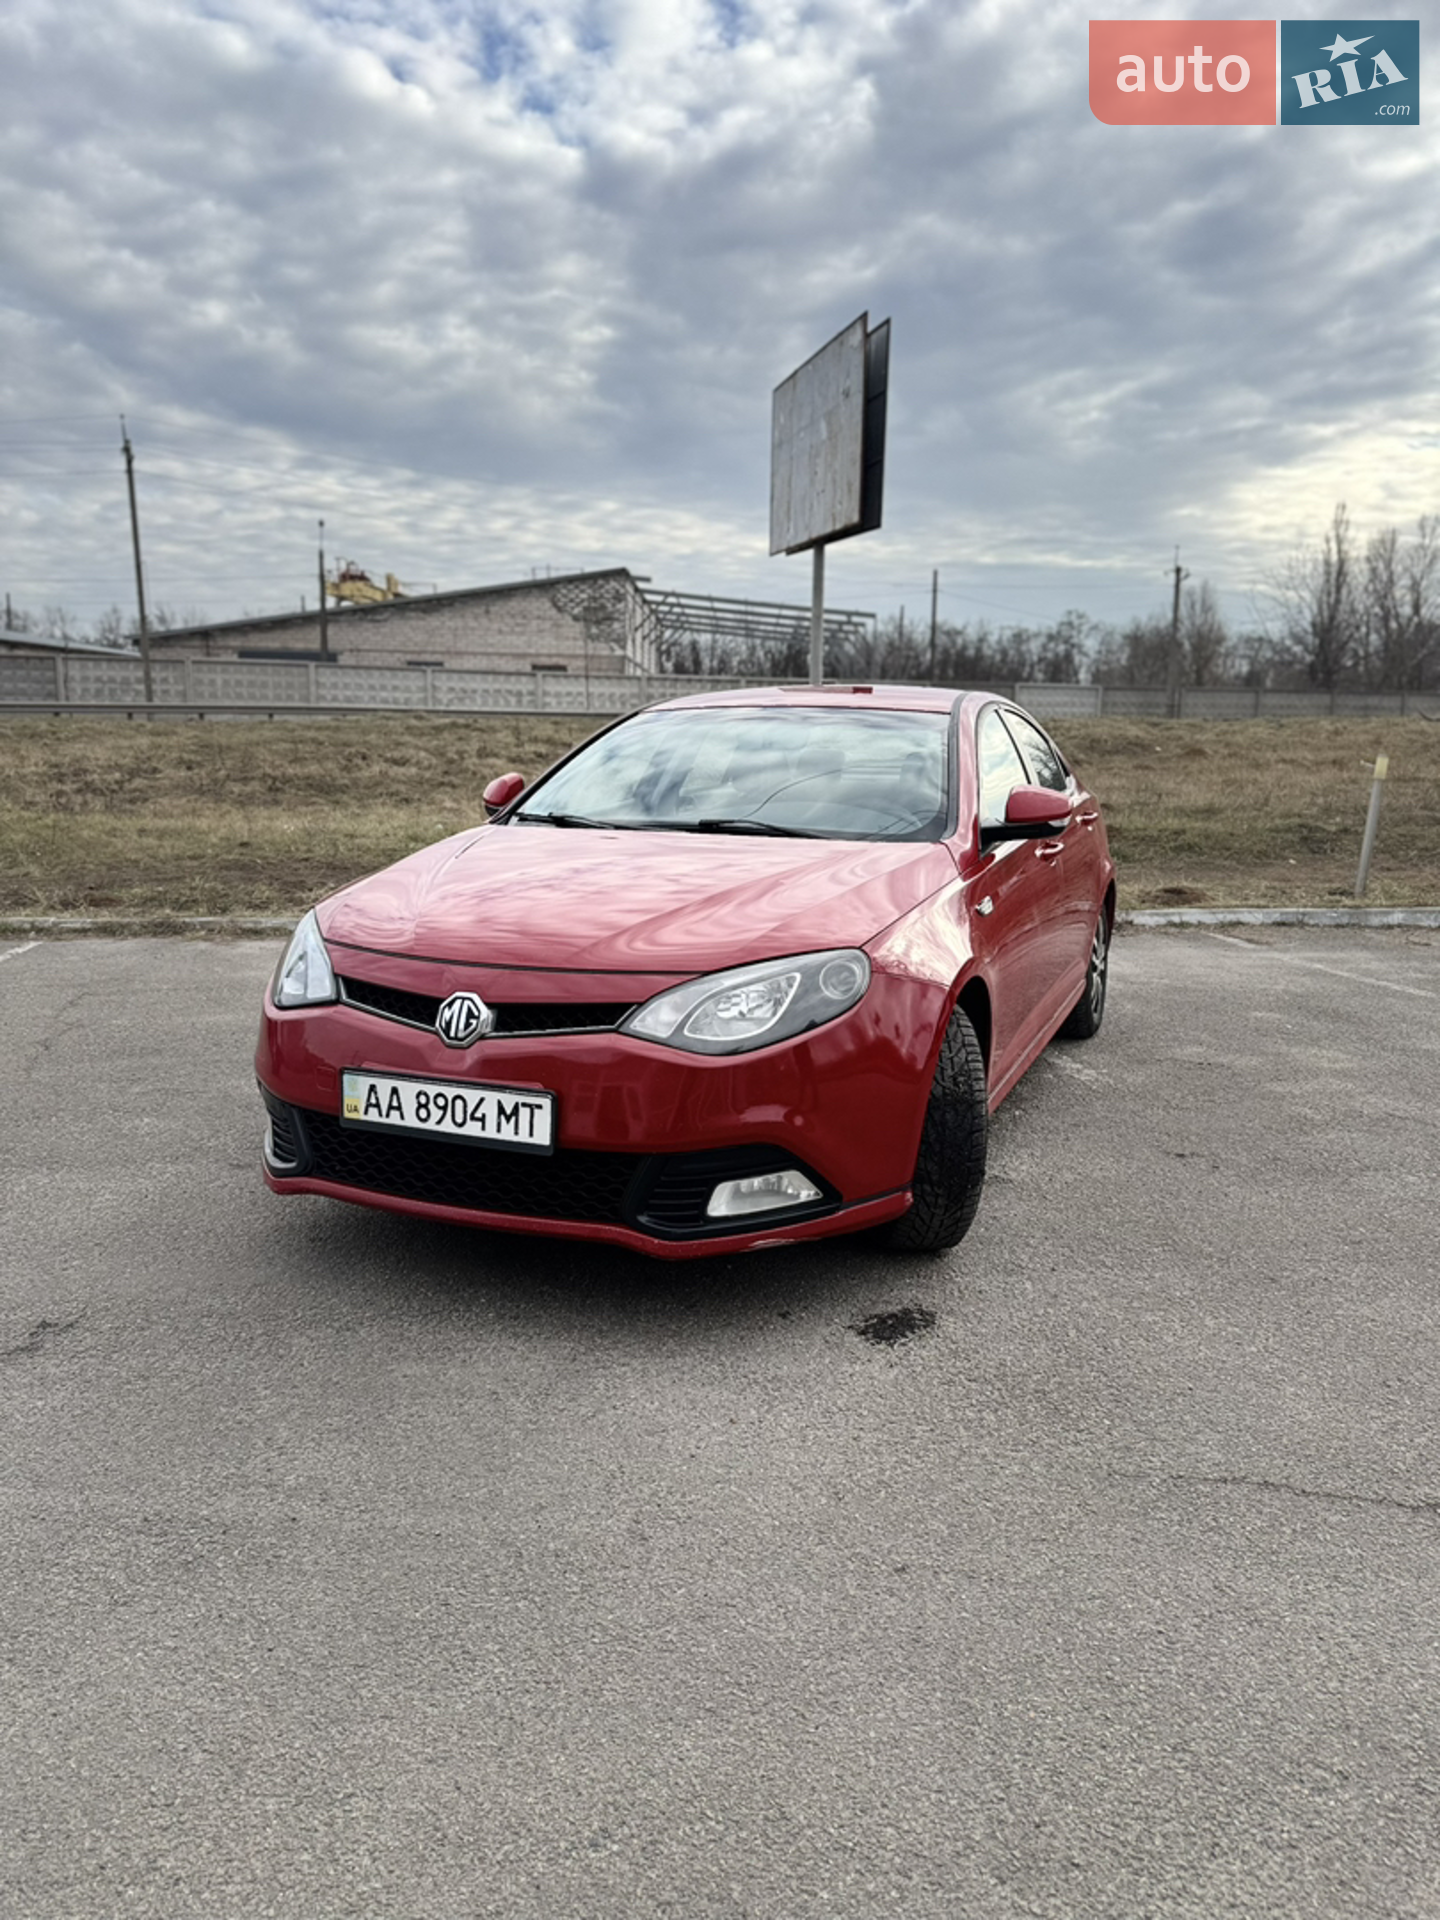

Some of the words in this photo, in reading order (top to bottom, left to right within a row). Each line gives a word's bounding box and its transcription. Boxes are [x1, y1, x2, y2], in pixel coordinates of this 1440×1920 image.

[441, 999, 479, 1038] MG
[346, 1105, 359, 1114] UA
[364, 1084, 405, 1121] AA
[415, 1090, 486, 1131] 8904
[496, 1098, 543, 1138] MT
